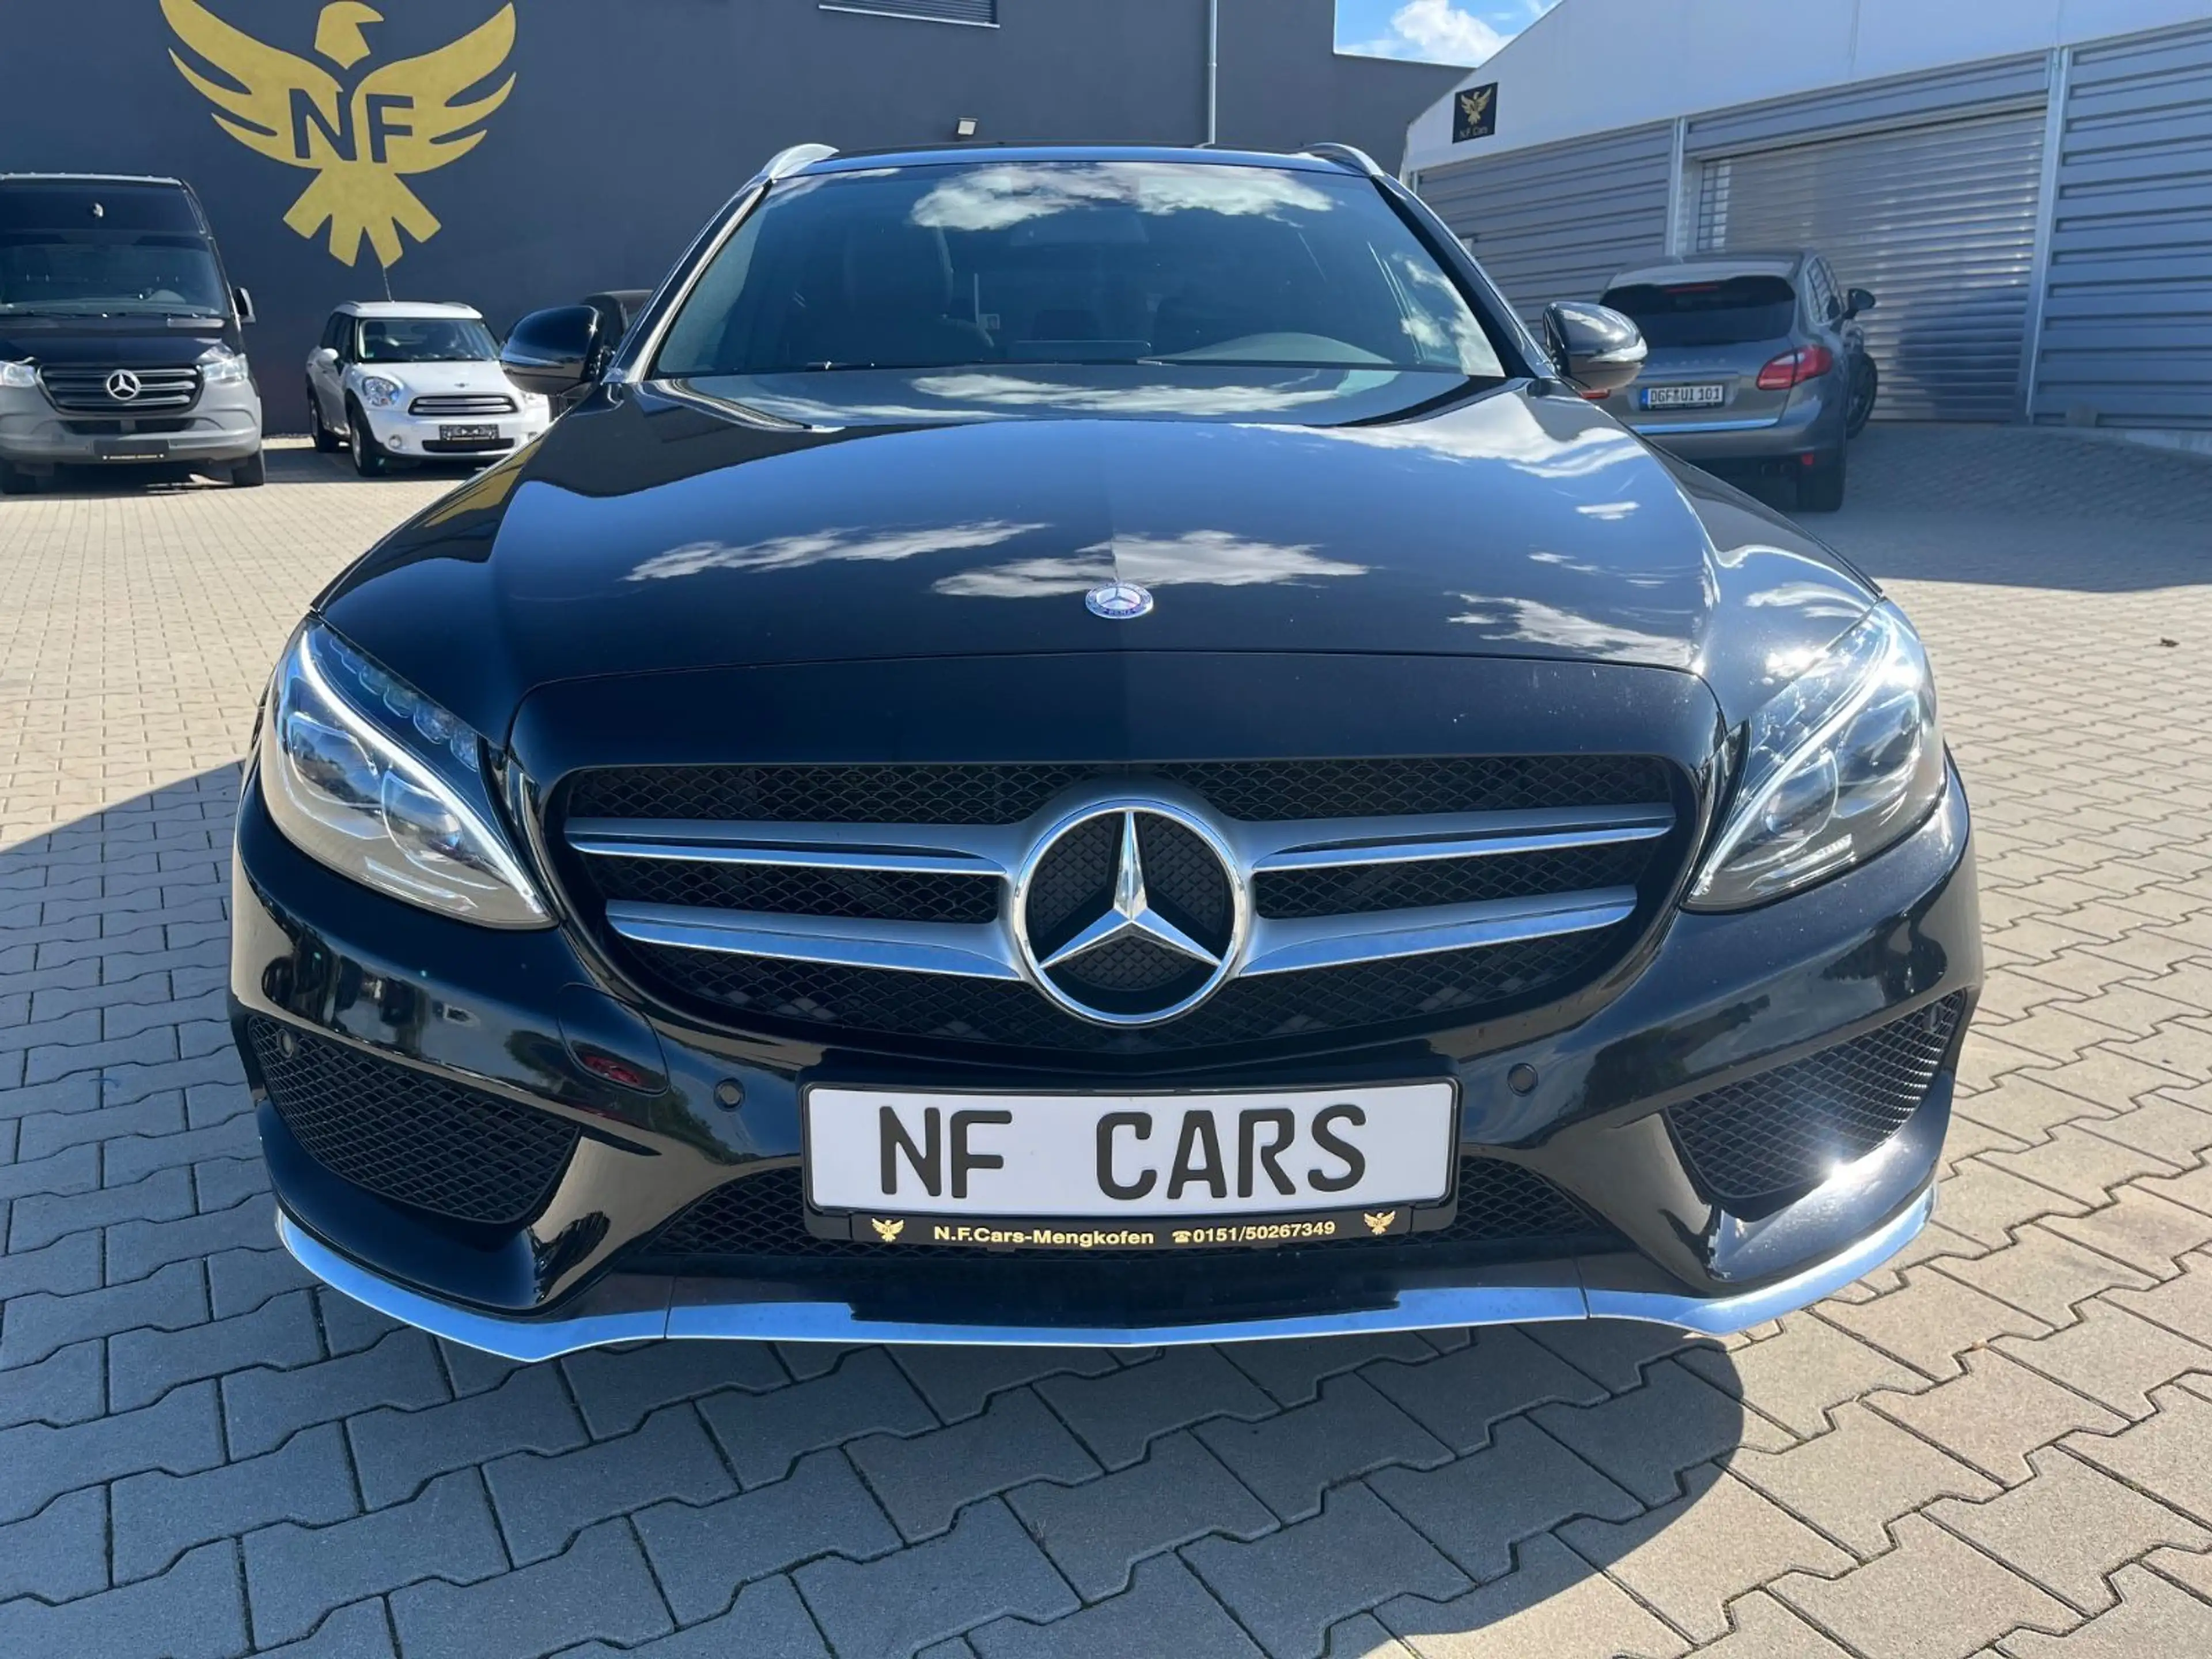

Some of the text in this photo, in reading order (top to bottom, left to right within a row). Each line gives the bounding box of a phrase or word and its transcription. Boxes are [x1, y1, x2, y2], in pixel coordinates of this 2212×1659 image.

[289, 88, 414, 163] NF
[1651, 389, 1674, 402] DGF
[1698, 387, 1719, 401] 101
[879, 1104, 1366, 1200] NF CARS
[934, 1221, 1335, 1248] N.F.Cars-Mengkofen 0151/50267349
